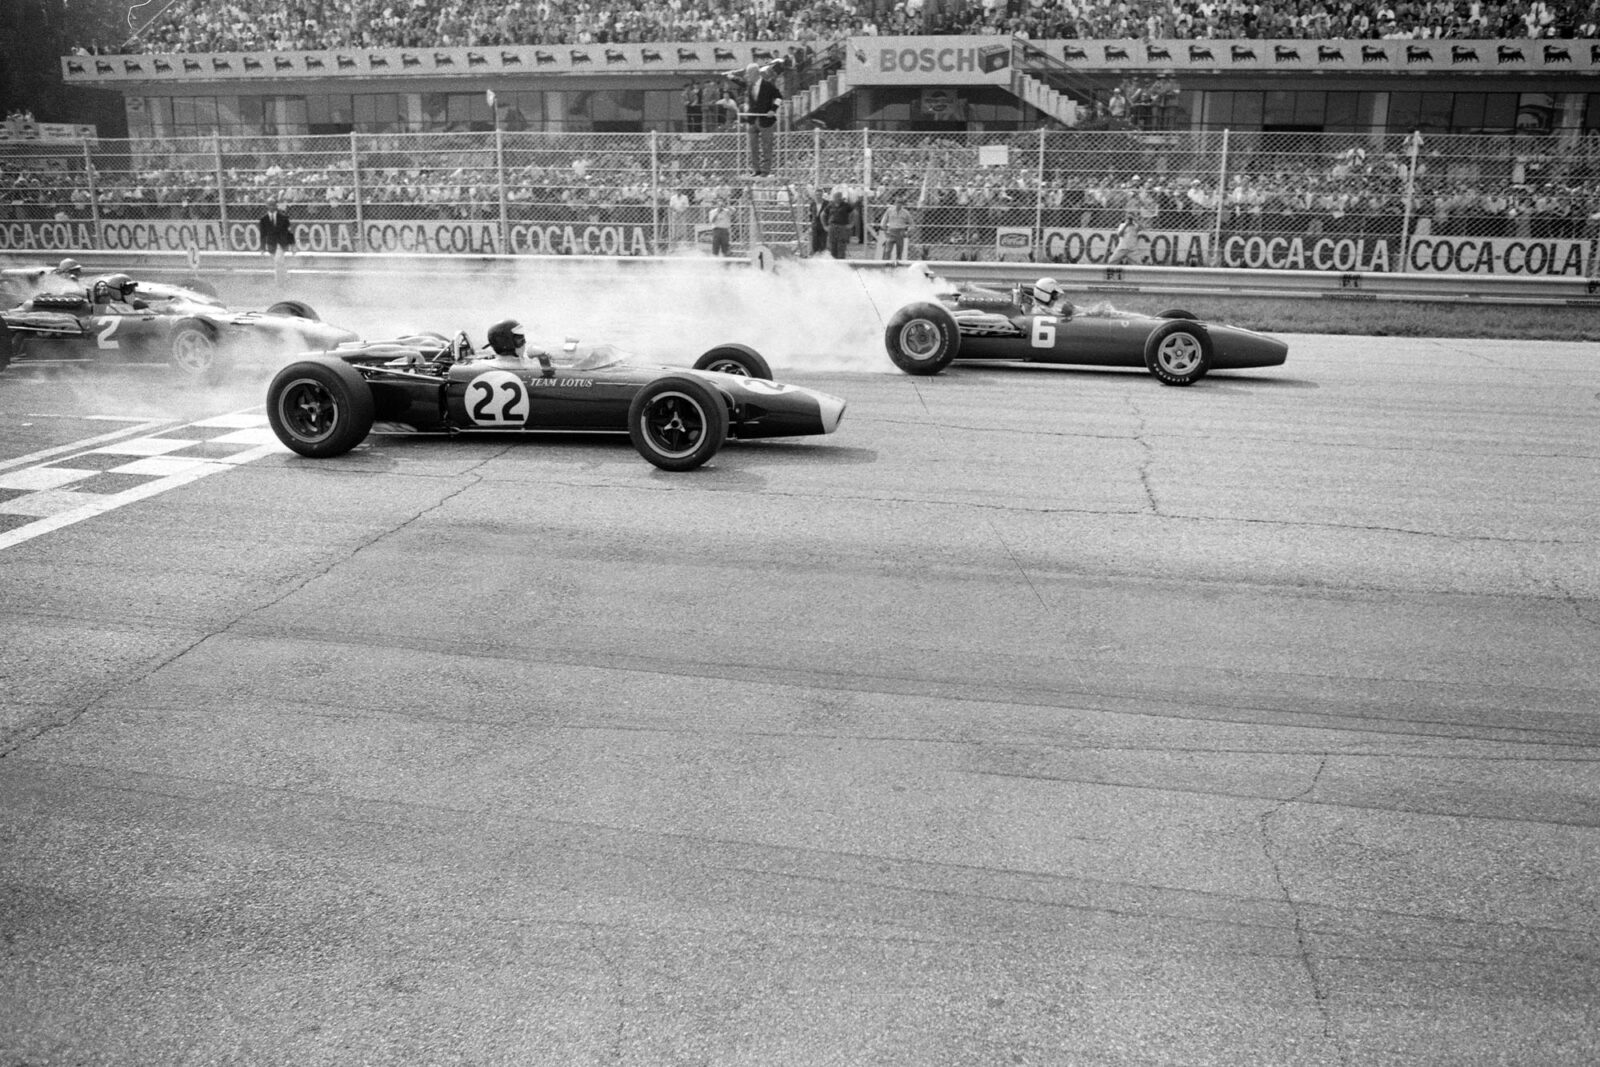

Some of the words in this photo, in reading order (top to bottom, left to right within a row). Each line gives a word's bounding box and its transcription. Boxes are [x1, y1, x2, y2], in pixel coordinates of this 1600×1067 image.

[880, 48, 975, 73] BOSCH
[103, 223, 220, 251] COCA-COLA
[366, 224, 499, 254] COCA-COLA
[511, 225, 649, 256] COCA-COLA
[1223, 235, 1390, 273] COCA-COLA
[1410, 239, 1583, 276] COCA-COLA
[97, 315, 122, 349] 2
[1031, 316, 1057, 348] 6
[530, 378, 557, 387] TEAM
[561, 378, 593, 388] LOTUS
[472, 380, 525, 421] 22
